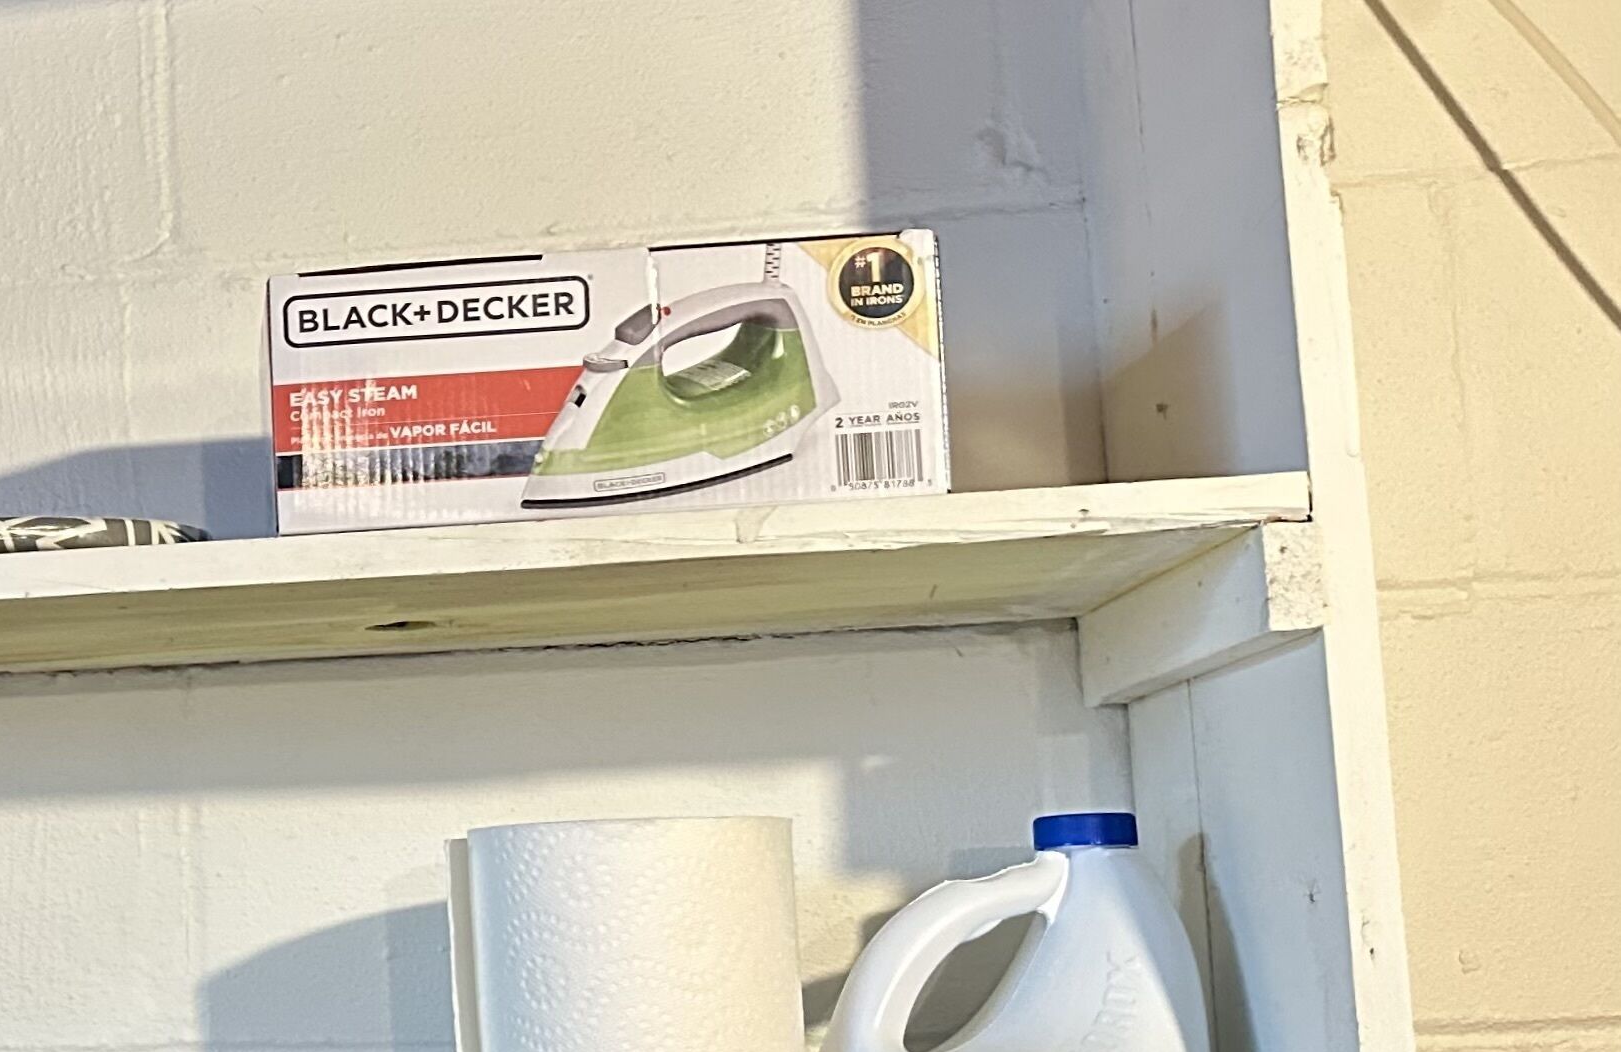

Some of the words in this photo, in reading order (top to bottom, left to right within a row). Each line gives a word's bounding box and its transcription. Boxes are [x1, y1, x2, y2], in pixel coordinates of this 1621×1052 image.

[850, 283, 904, 297] BRAND
[851, 298, 863, 307] IN
[866, 295, 904, 306] IRONS
[297, 291, 575, 333] BLACK+DECKER
[289, 388, 343, 407] EASY
[349, 384, 418, 403] STEAM
[357, 407, 386, 419] Iron
[835, 417, 844, 429] 2
[848, 414, 881, 425] YEAR
[886, 411, 921, 422] AÑOS
[390, 424, 446, 438] VAPOR
[450, 419, 497, 436] FÁCIL
